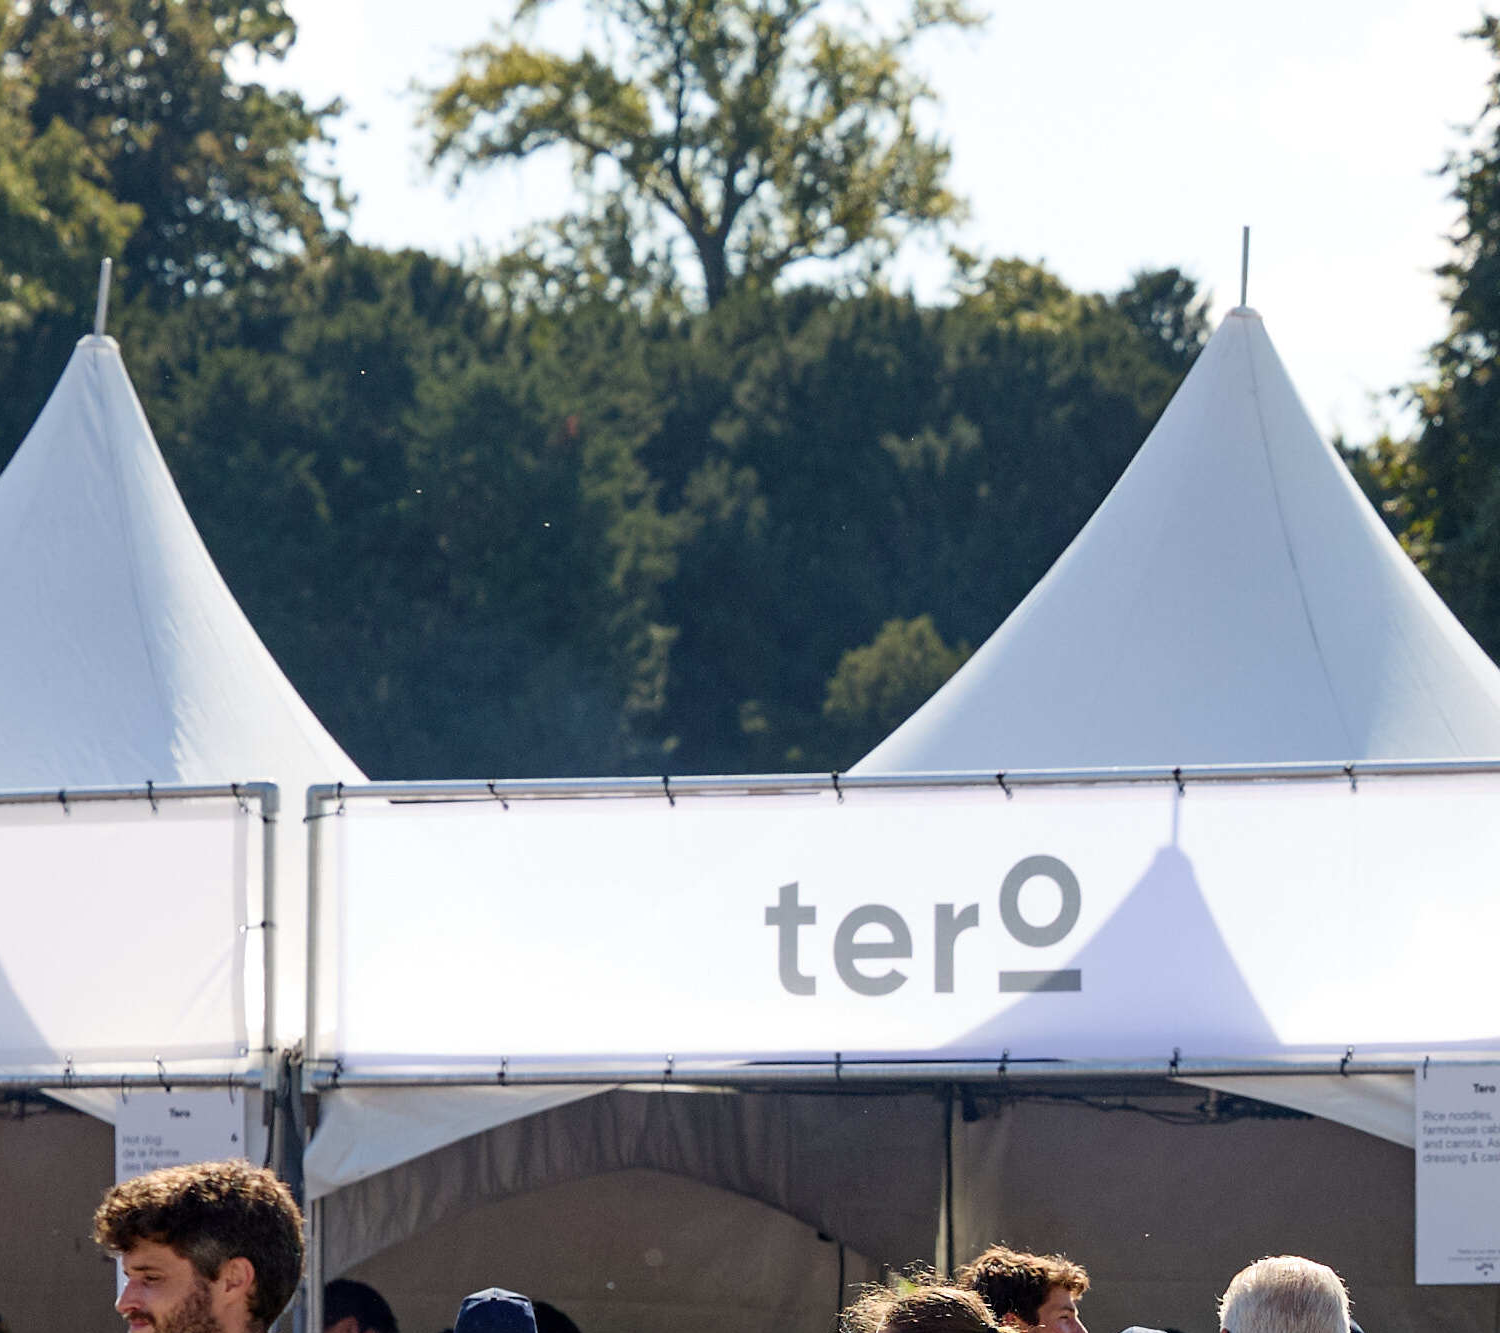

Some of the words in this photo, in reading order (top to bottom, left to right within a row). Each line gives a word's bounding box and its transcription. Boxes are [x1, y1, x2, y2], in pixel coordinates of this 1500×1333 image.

[1473, 1083, 1496, 1094] Tero
[1422, 1111, 1446, 1121] Rice
[1423, 1125, 1478, 1135] farmhouse
[1423, 1138, 1443, 1149] and
[1423, 1153, 1468, 1165] dressing
